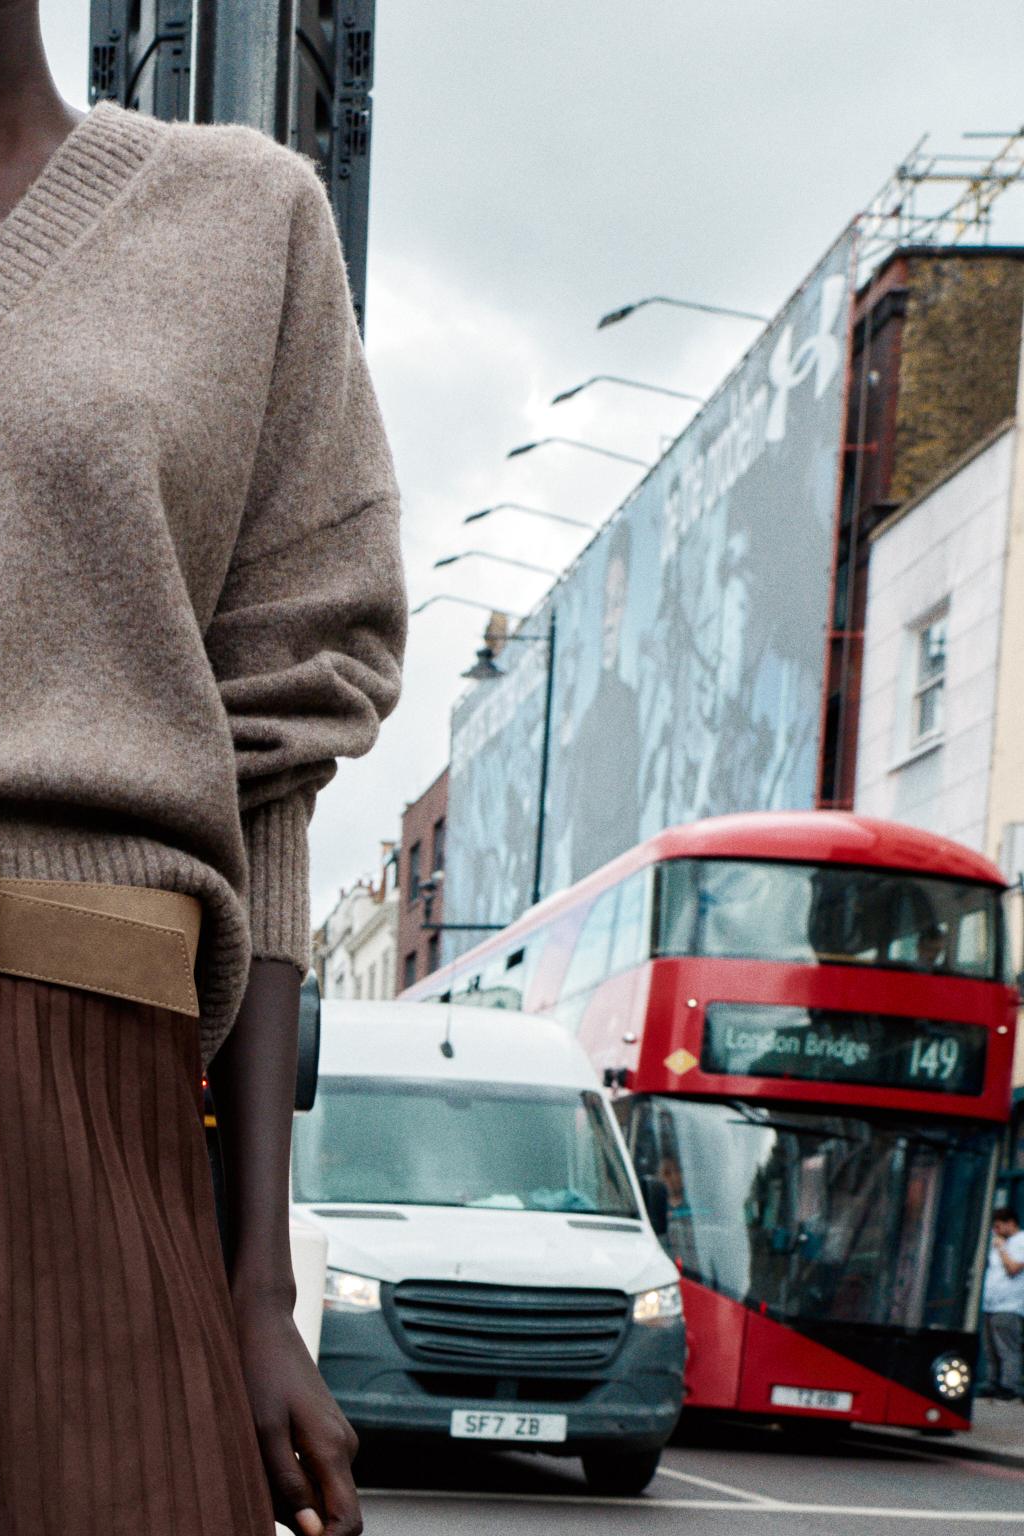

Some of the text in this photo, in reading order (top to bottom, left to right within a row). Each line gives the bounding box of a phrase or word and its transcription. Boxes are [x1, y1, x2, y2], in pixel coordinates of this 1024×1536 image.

[805, 1032, 869, 1066] Bridge
[910, 1037, 958, 1080] 149
[516, 1418, 540, 1435] ZB
